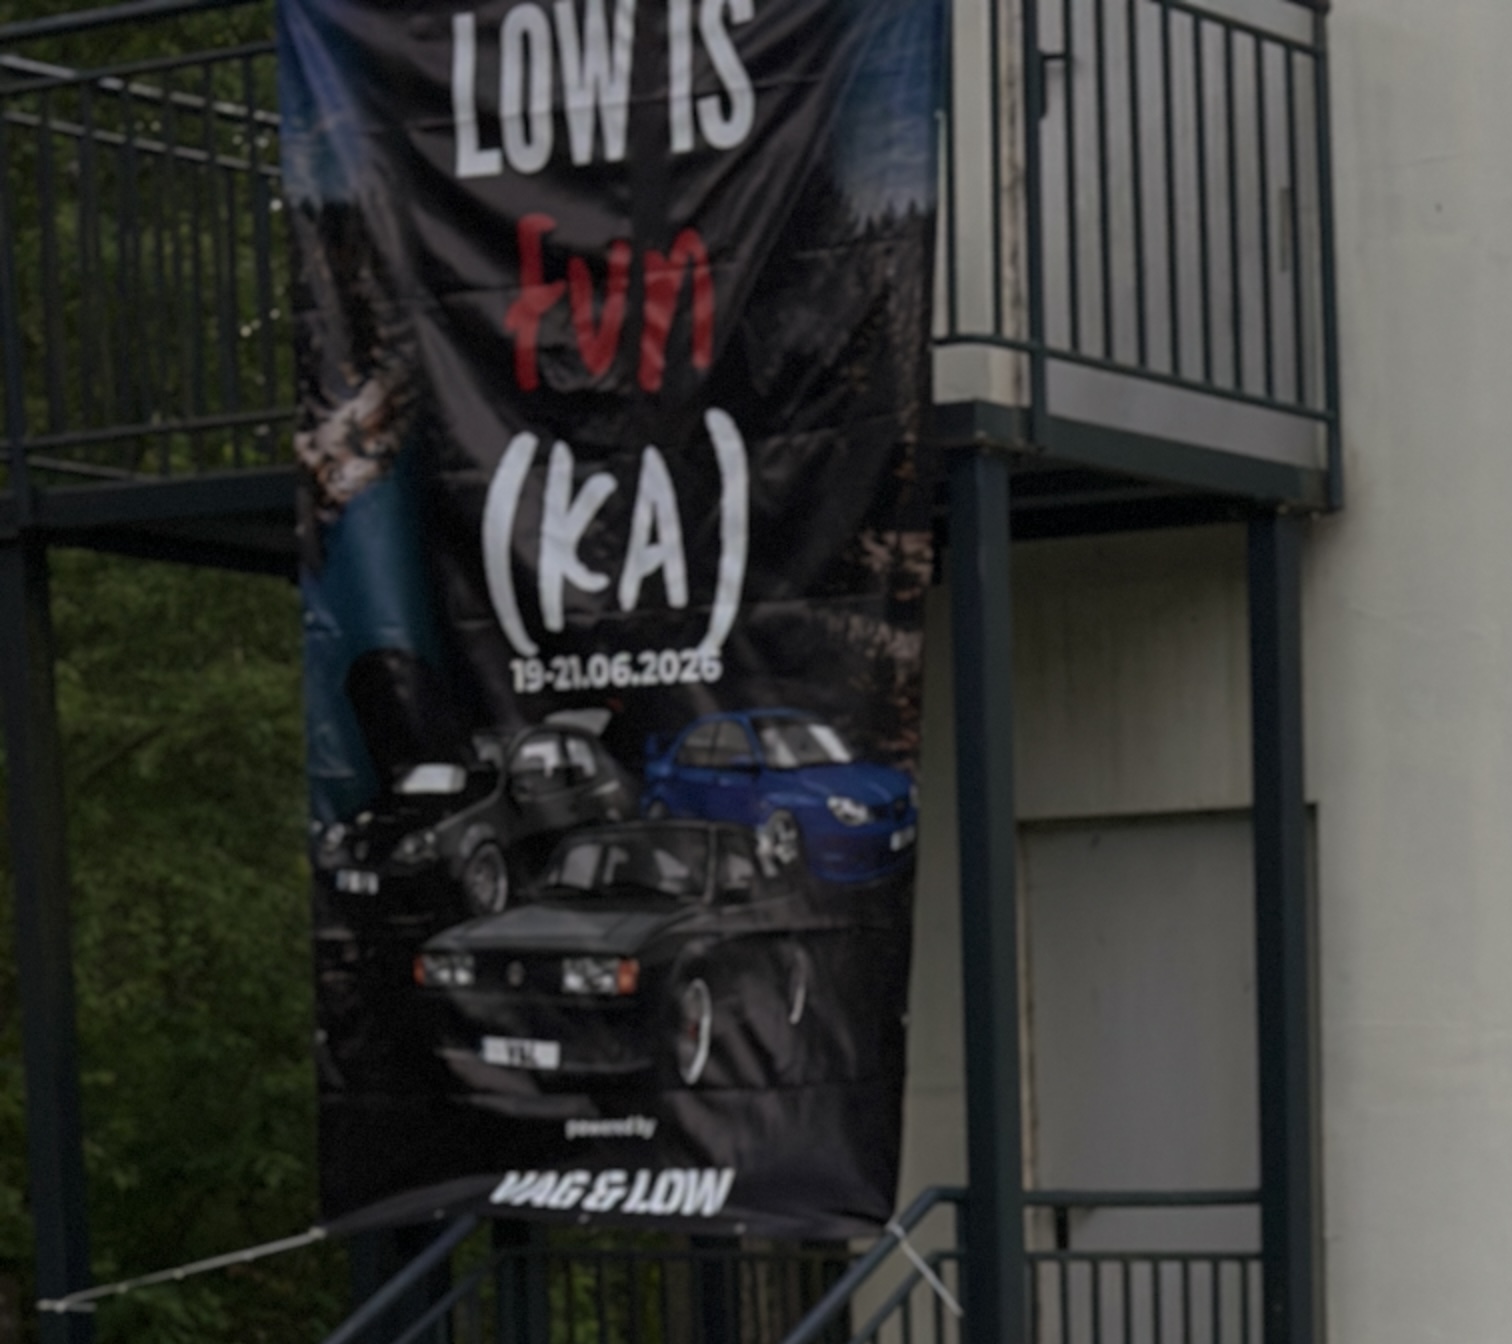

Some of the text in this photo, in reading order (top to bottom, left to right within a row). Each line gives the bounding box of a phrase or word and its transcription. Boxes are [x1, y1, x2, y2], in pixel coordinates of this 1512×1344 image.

[452, 0, 755, 178] LOW IS
[510, 649, 723, 693] 19-21.06.2026
